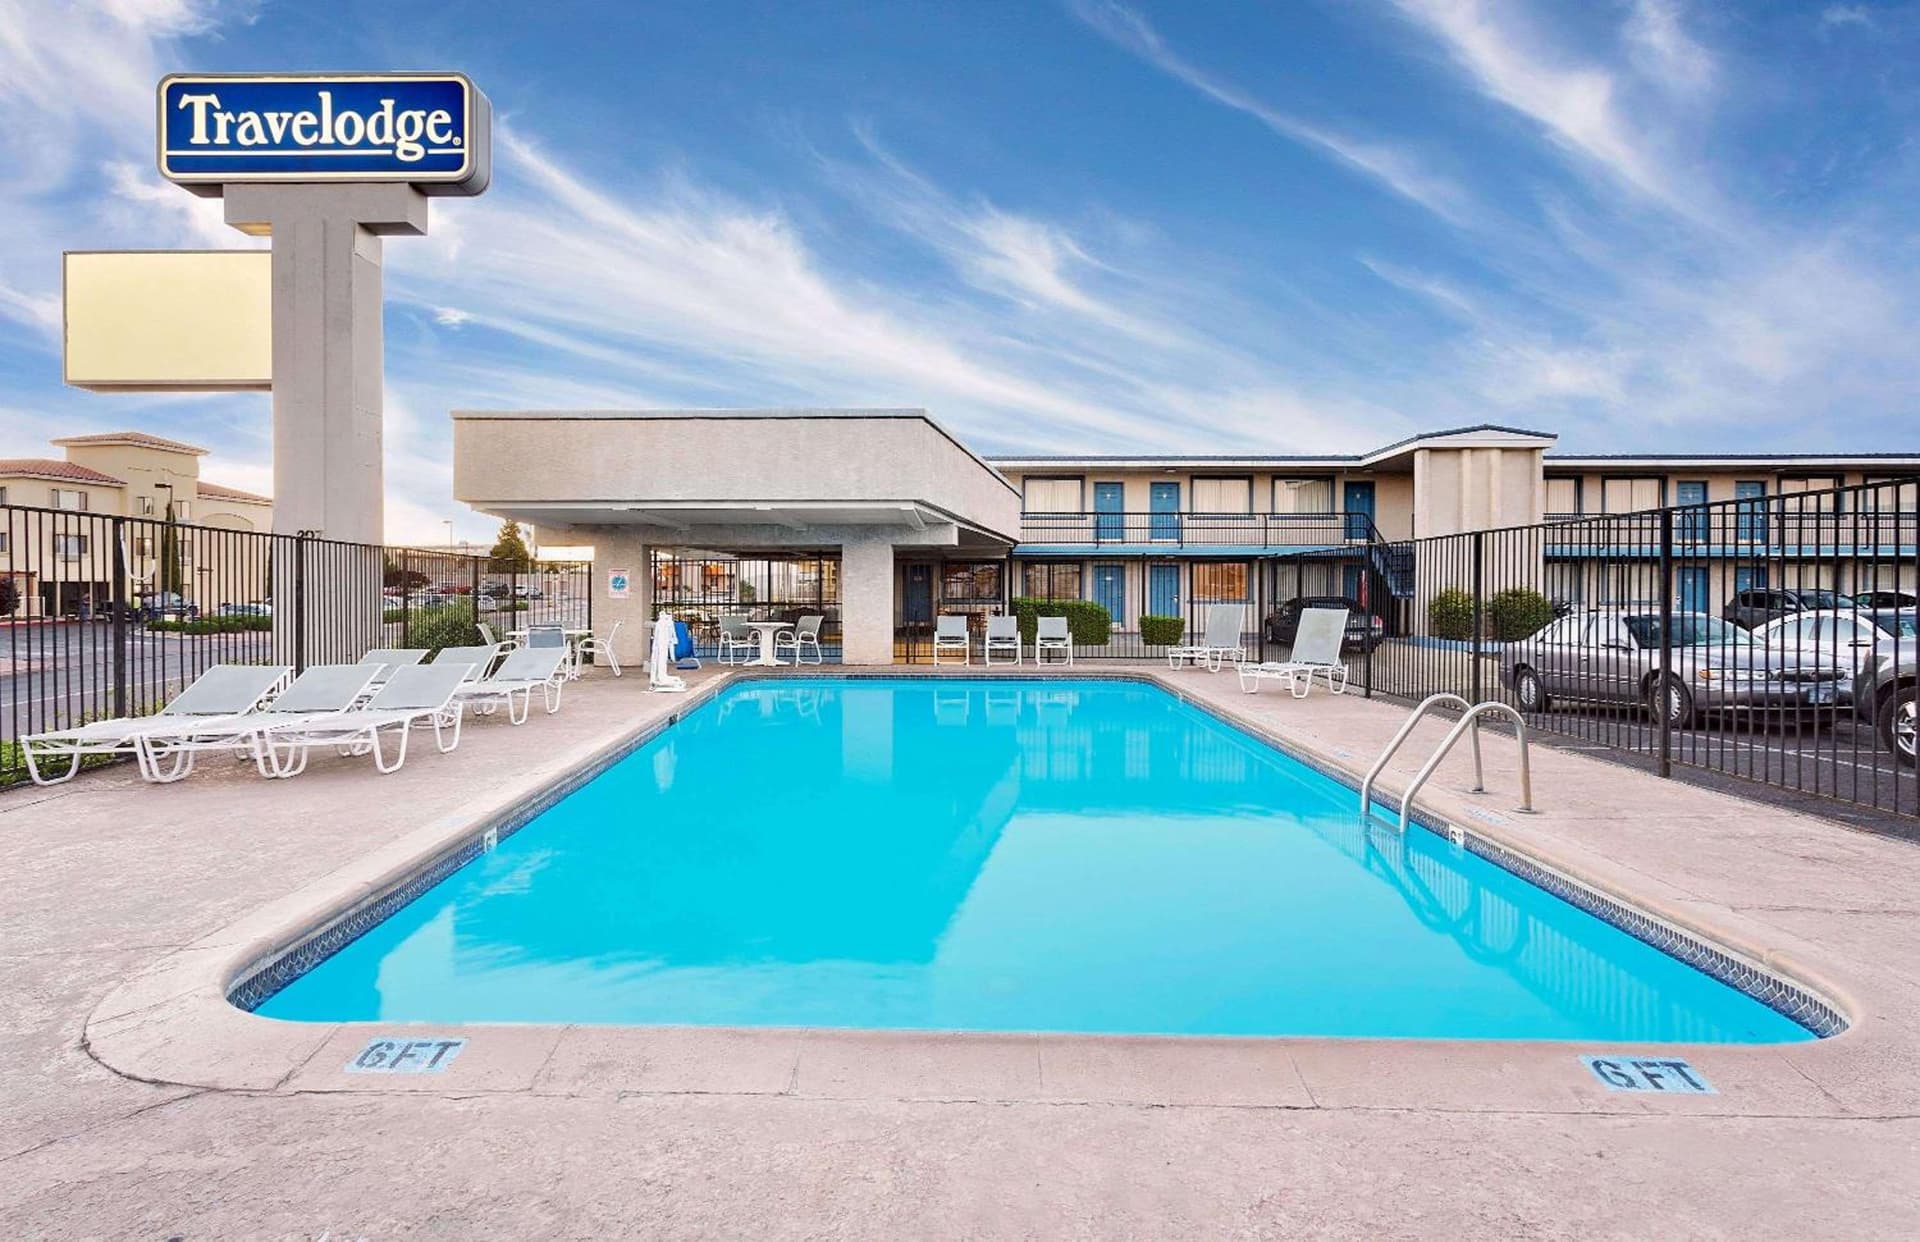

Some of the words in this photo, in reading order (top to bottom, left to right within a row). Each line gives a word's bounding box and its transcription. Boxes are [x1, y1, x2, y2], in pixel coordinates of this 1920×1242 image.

[178, 91, 453, 162] Travelodge
[355, 1041, 462, 1069] 6FT
[1591, 1059, 1705, 1091] 6FT
